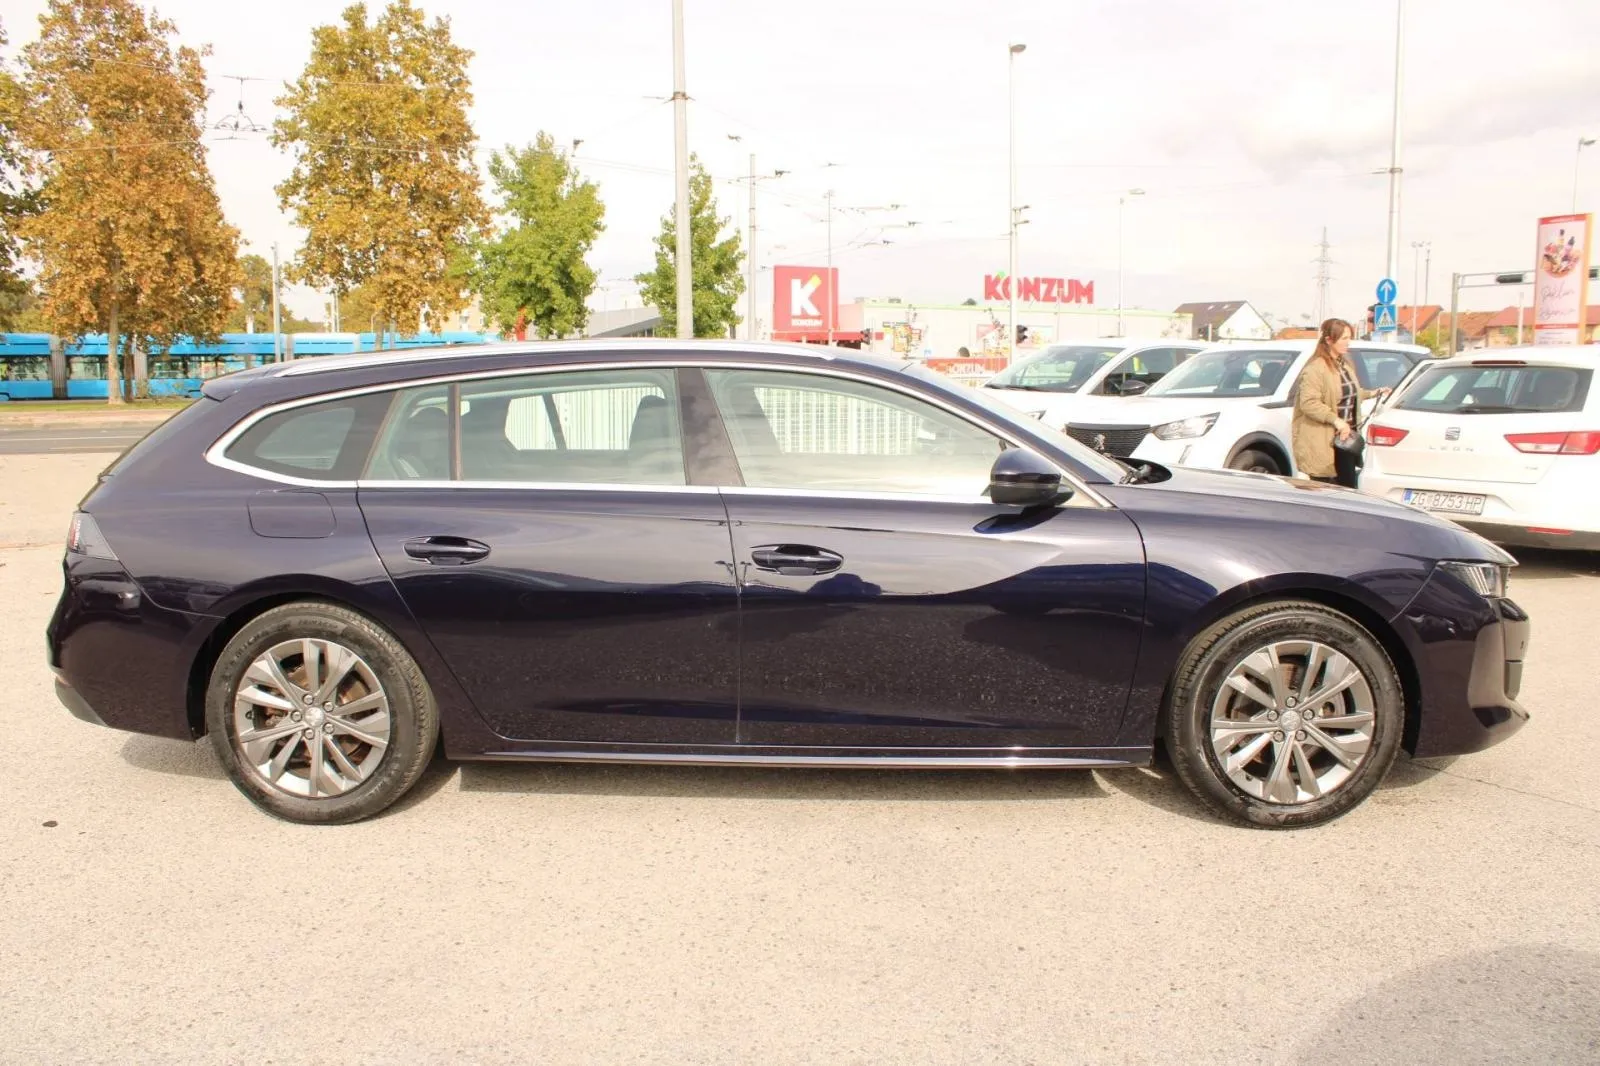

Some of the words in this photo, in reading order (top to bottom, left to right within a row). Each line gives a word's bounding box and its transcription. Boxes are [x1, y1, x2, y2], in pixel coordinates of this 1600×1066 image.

[791, 273, 822, 316] K
[984, 271, 1095, 304] KONZUM
[1410, 492, 1426, 505] ZG
[1433, 493, 1465, 509] 8753
